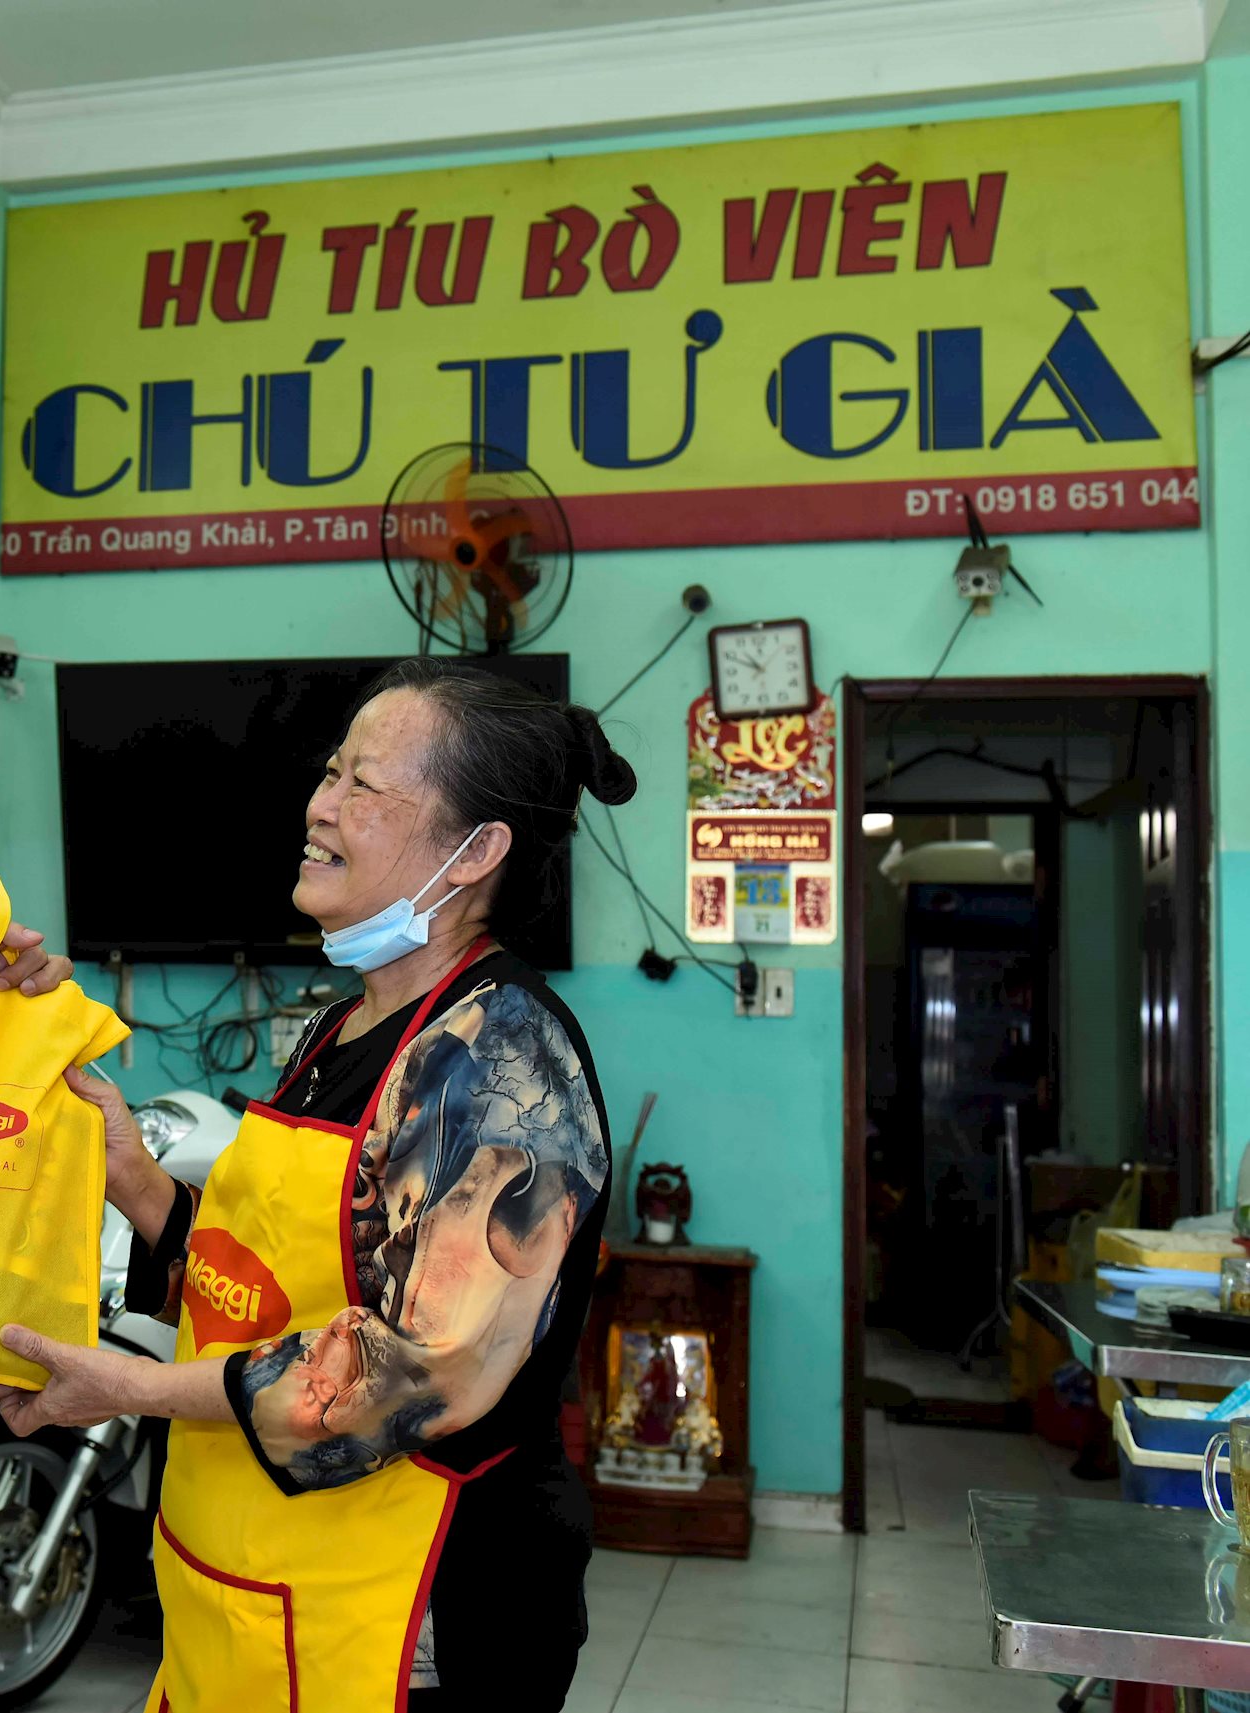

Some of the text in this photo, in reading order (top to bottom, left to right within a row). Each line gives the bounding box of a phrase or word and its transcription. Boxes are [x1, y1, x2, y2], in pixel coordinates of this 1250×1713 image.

[139, 161, 1008, 330] HỦ TÍU BÒ VIÊN
[21, 286, 1163, 499] CHÚ TƯ GIÀ
[905, 478, 1199, 517] ĐT: 0918 651 044
[29, 525, 92, 555] Trần
[101, 526, 192, 555] Quang
[201, 517, 275, 548] Khải,
[284, 517, 368, 542] P.Tân
[186, 1250, 263, 1323] Maggi
